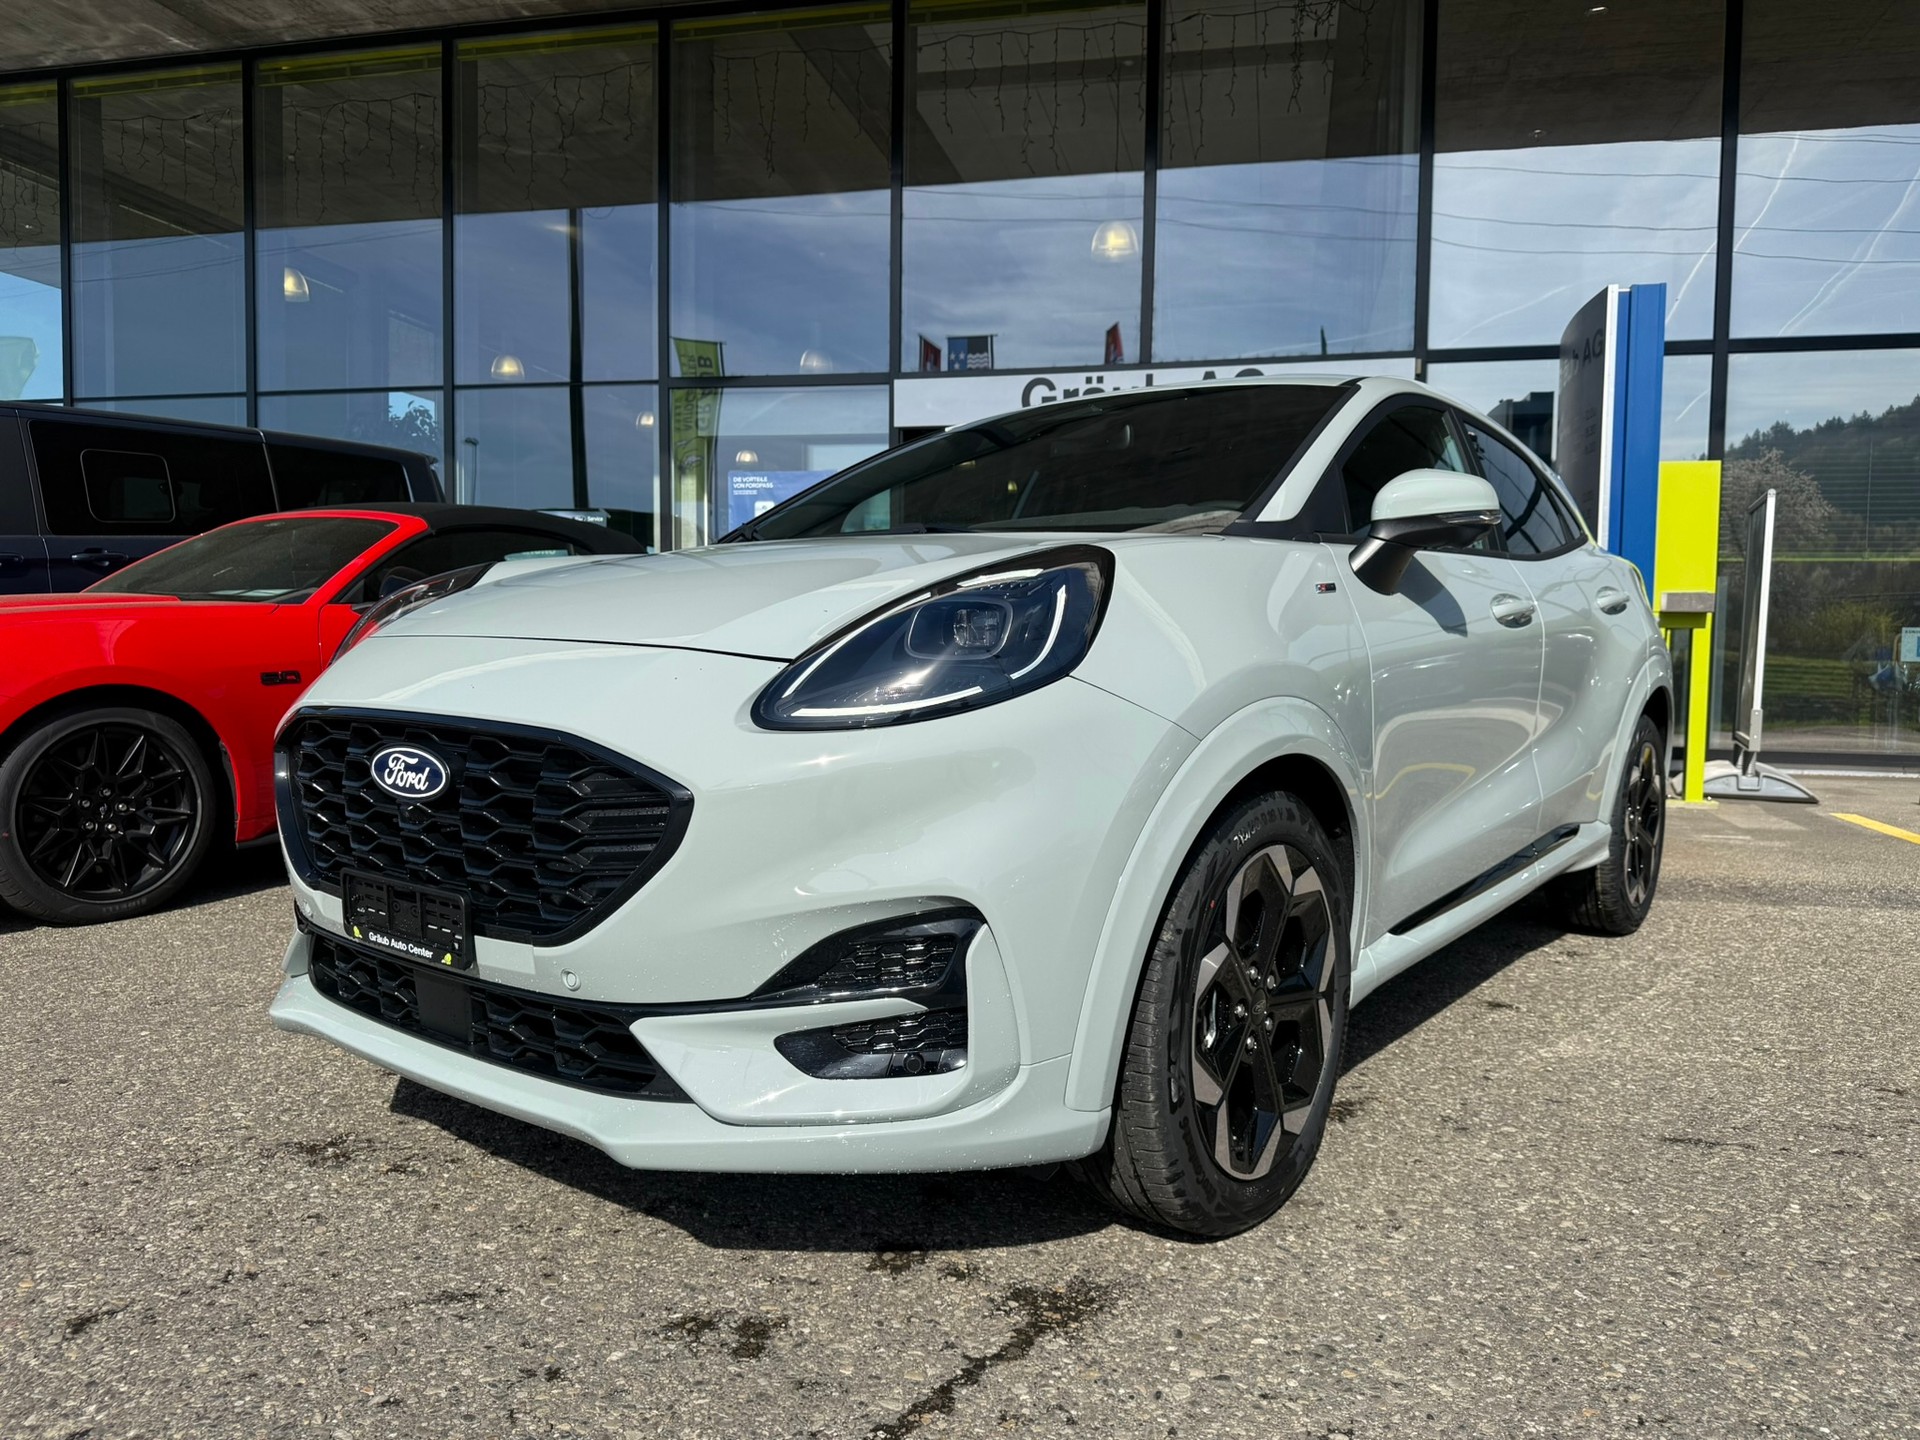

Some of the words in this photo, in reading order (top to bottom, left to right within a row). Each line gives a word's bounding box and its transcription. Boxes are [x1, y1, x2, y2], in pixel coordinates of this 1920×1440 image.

[384, 753, 430, 791] Ford
[368, 931, 389, 946] Gräub
[390, 938, 407, 951] Auto
[408, 943, 434, 958] Center
